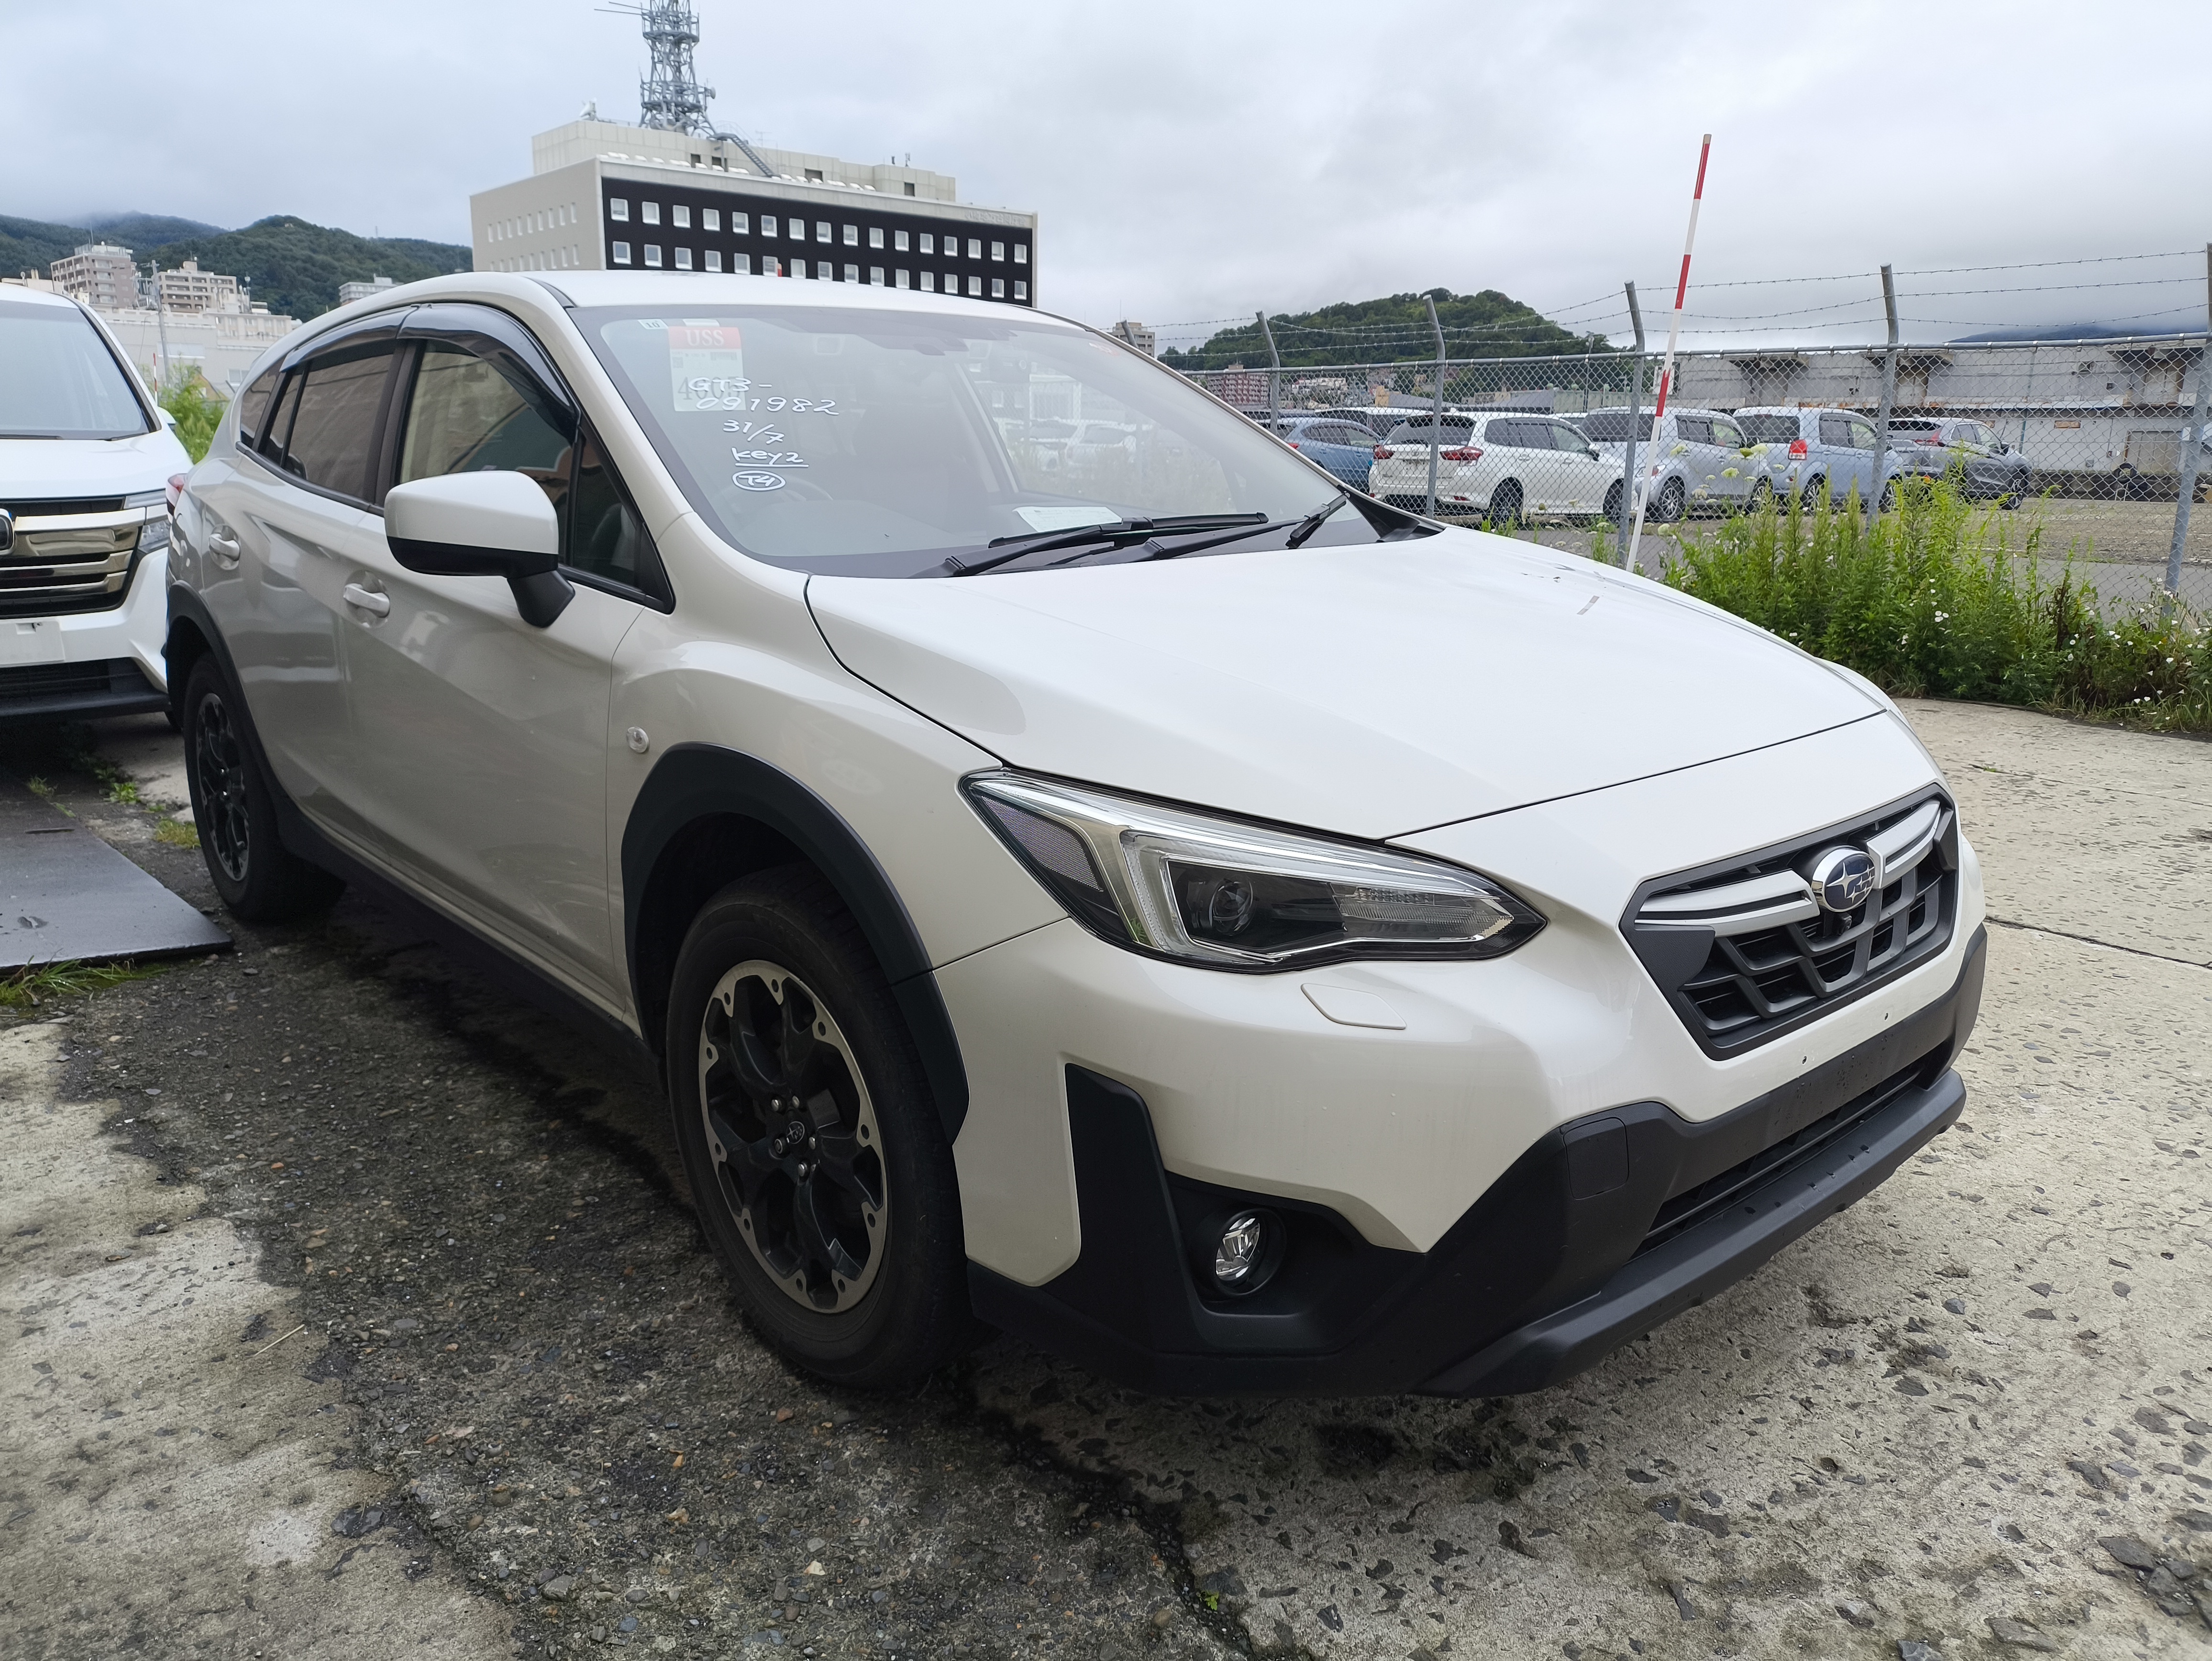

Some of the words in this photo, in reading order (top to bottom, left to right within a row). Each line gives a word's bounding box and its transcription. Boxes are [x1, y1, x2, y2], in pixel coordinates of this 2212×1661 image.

[685, 329, 725, 347] USS
[696, 397, 840, 415] 091982
[723, 420, 785, 444] 31/7
